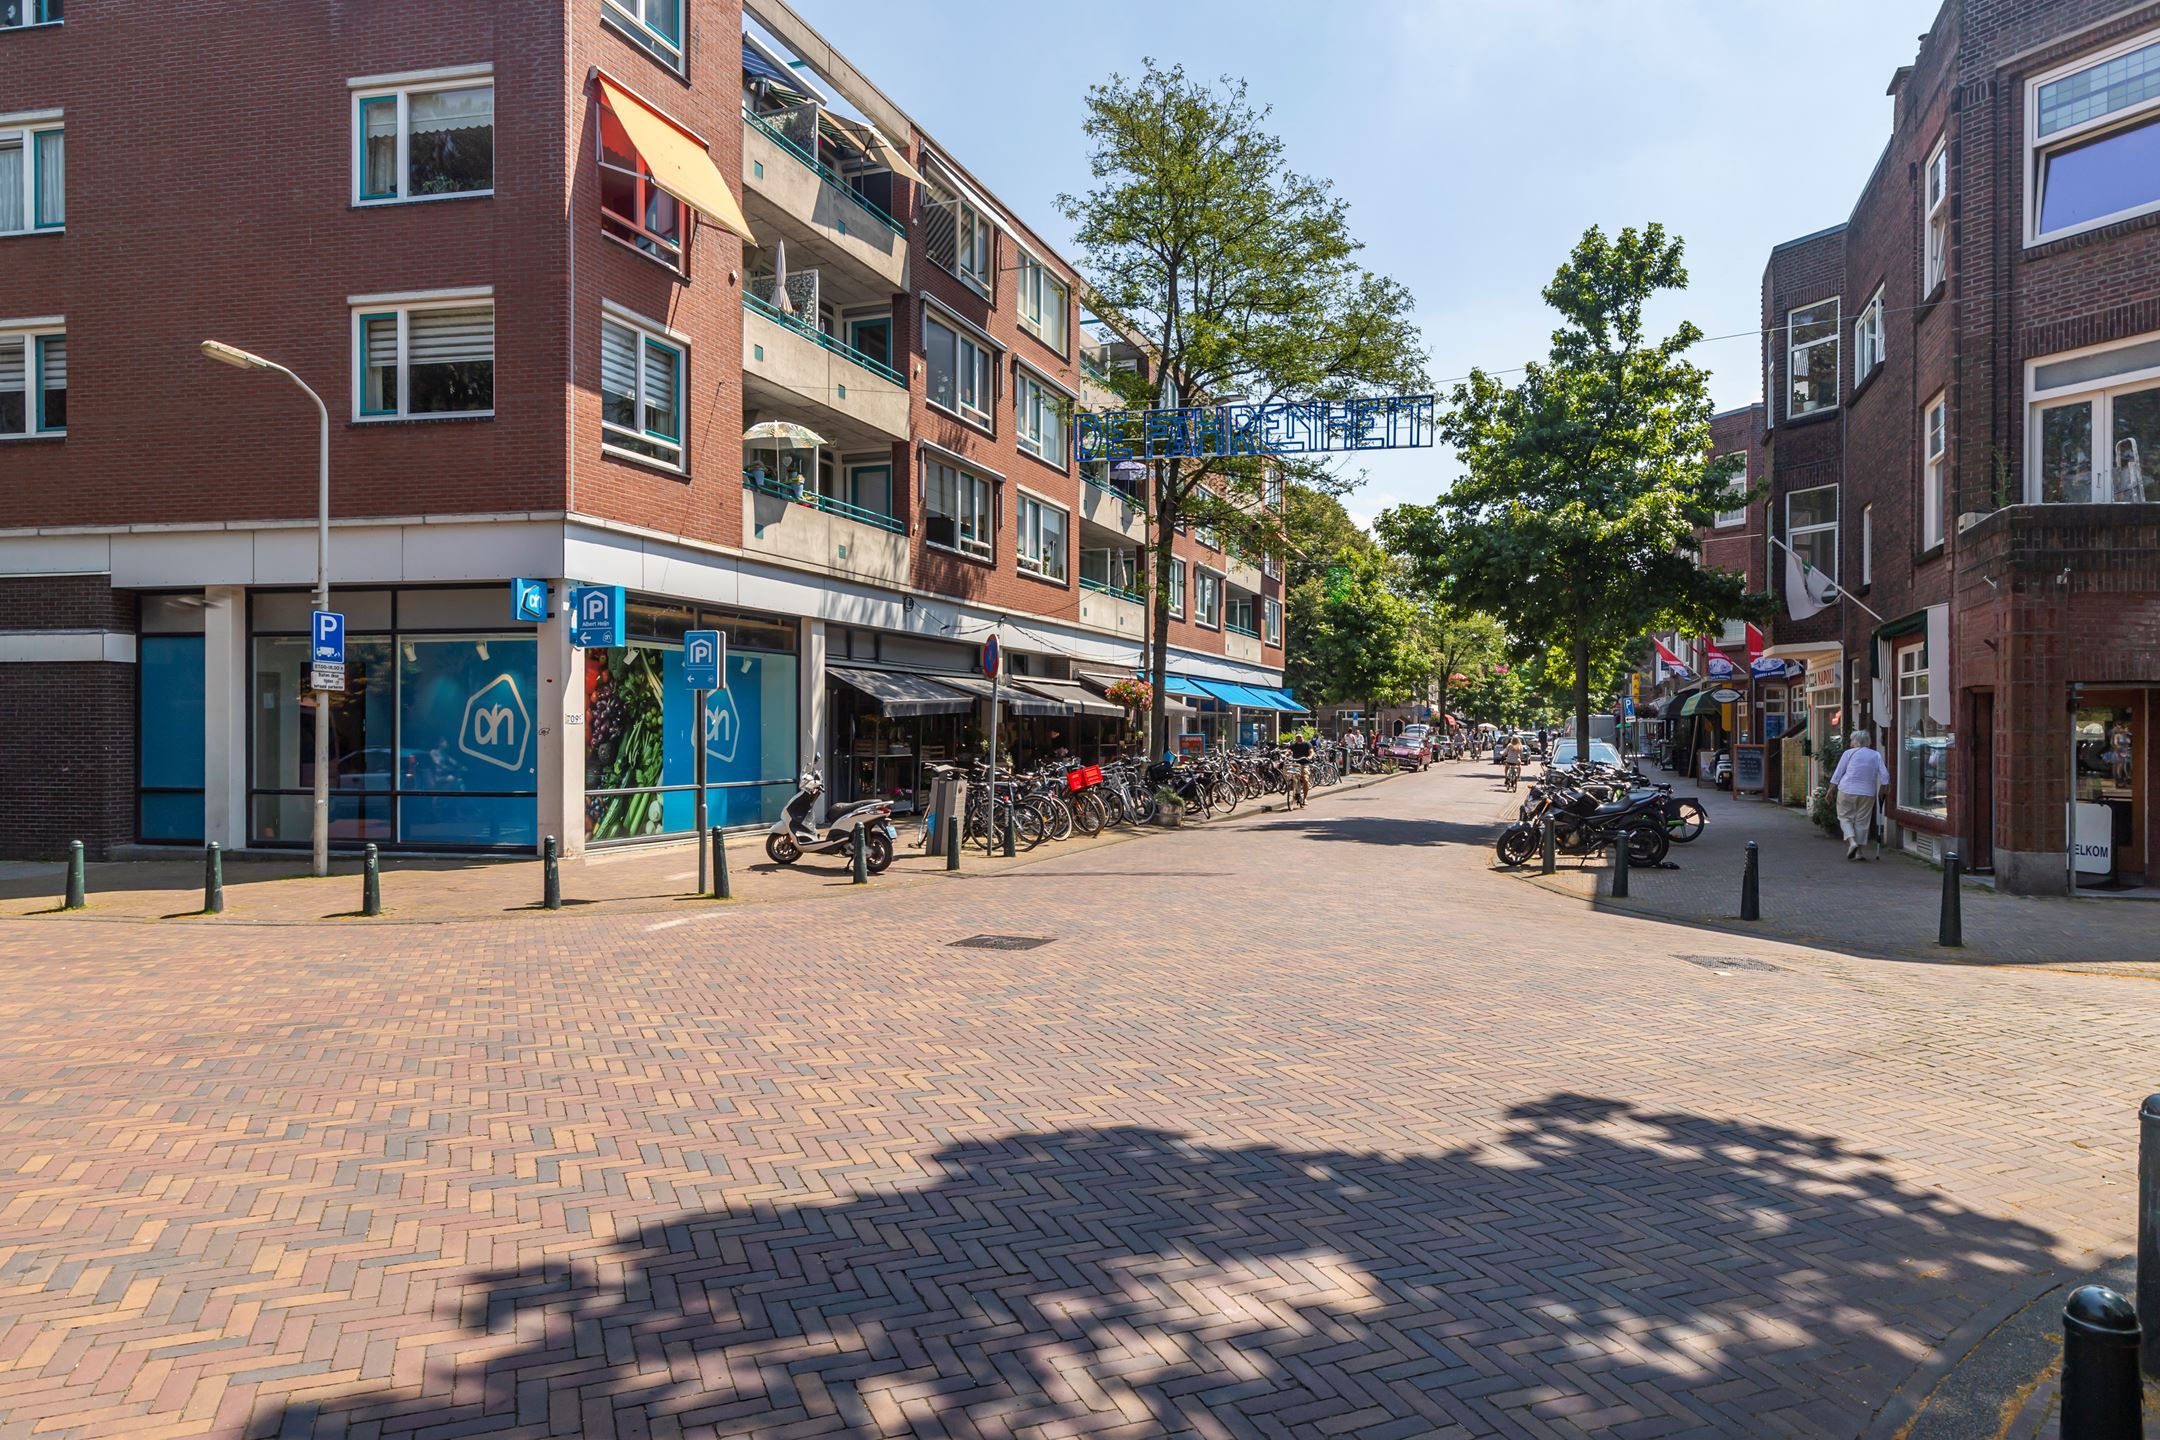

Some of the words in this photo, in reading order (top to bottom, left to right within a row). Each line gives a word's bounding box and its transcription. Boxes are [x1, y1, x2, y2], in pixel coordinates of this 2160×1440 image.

[1074, 411, 1133, 461] DE
[589, 600, 603, 620] P
[321, 615, 338, 641] P
[695, 646, 708, 663] P
[2074, 844, 2109, 858] ELKOM
